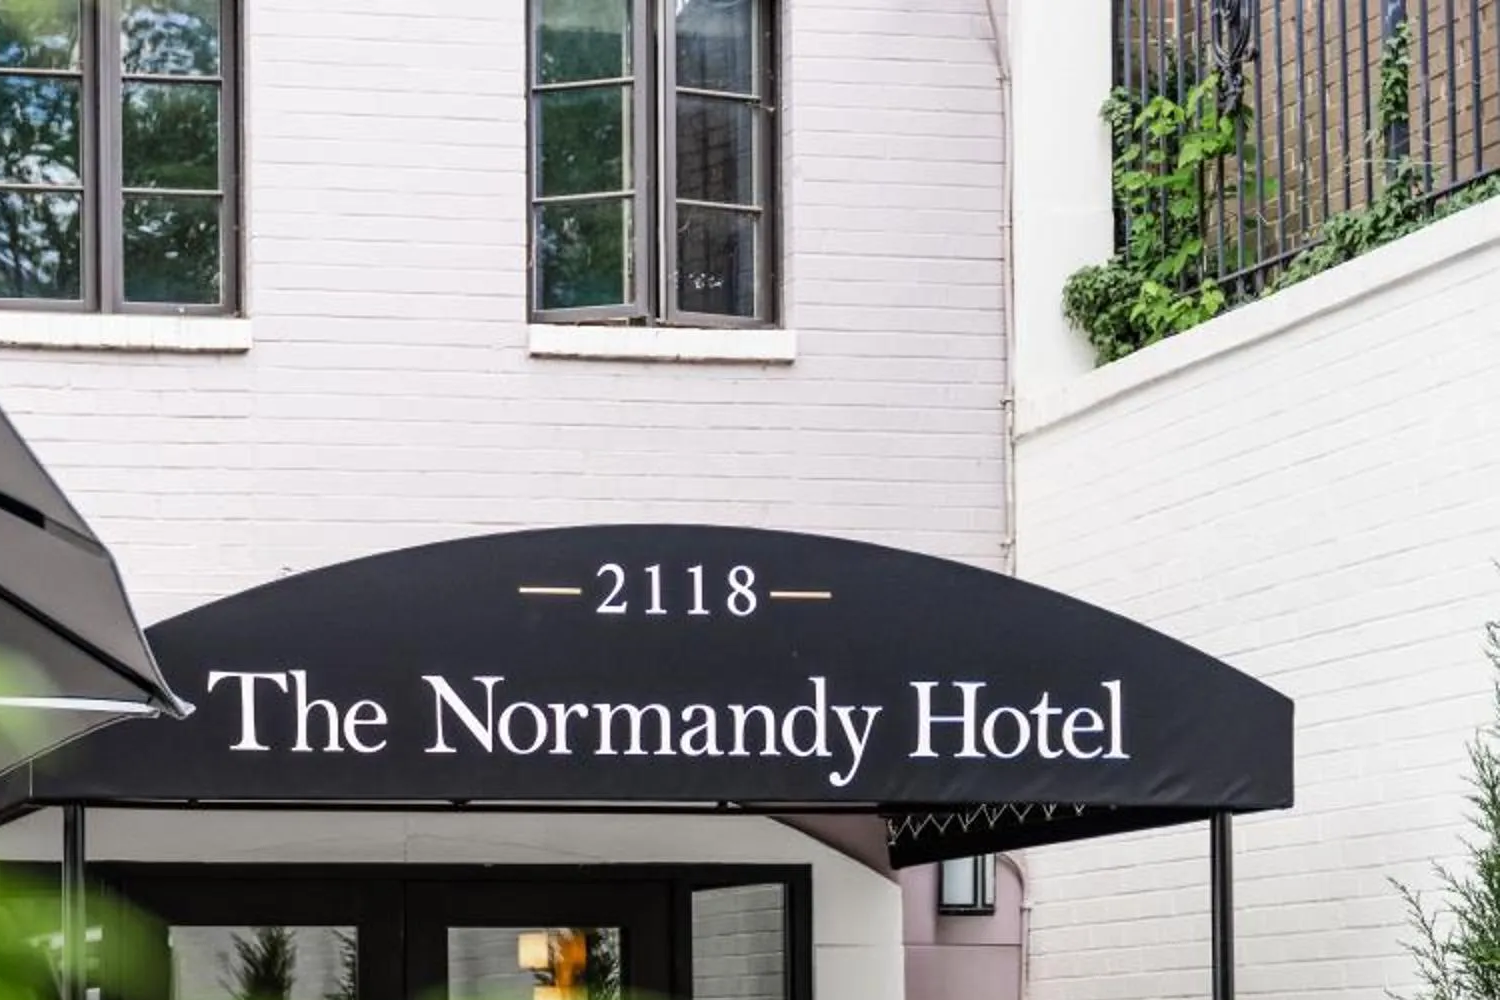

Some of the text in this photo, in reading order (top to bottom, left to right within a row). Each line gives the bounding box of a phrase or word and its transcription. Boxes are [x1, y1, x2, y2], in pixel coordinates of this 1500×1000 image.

[596, 563, 757, 617] 2118
[207, 670, 1130, 787] The Normandy Hotel
